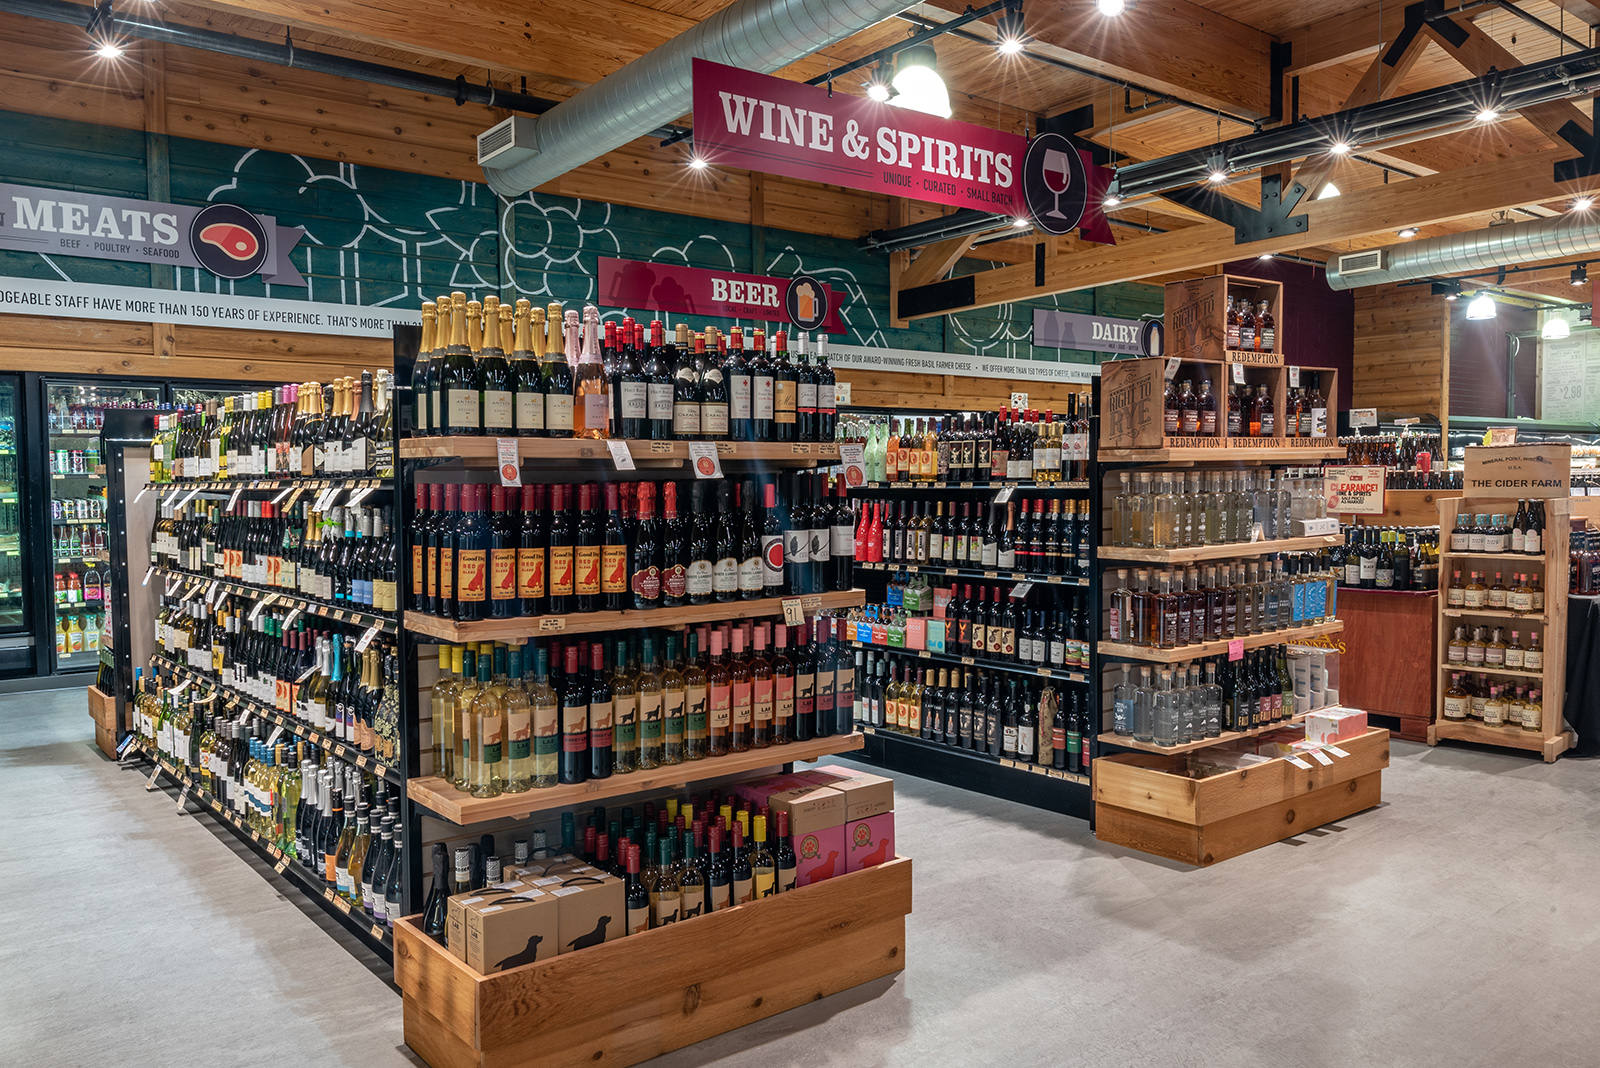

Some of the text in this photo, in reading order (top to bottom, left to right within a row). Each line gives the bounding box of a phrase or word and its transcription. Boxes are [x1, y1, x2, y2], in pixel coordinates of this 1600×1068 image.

[718, 91, 1013, 188] WINE & SPIRITS
[883, 171, 1013, 207] UNIQUE CURATED SMALL BATCH
[12, 196, 179, 246] MEATS
[60, 238, 180, 259] BEEF POULTRY SEAFOOD
[711, 278, 780, 308] BEER
[55, 294, 90, 309] STAFF
[93, 297, 122, 311] HAVE
[125, 300, 156, 314] MORE
[158, 302, 187, 317] THAN
[191, 305, 209, 318] 150
[211, 306, 245, 320] YEARS
[247, 309, 260, 321] OF
[263, 310, 324, 326] EXPERIENCE.
[327, 315, 358, 328] THAT'S
[360, 318, 385, 330] MORE
[722, 305, 780, 317] LOCAL CRAFT LIMITED
[1172, 299, 1214, 331] RIGHT TO
[1092, 321, 1140, 344] DAIRY
[1232, 351, 1280, 364] REDEMPTION
[844, 353, 851, 363] OF
[851, 354, 863, 364] OUR
[863, 355, 905, 367] AWARD-WINNING
[905, 358, 921, 367] FRESH
[921, 359, 935, 369] BASIL
[936, 360, 954, 370] FARMER
[955, 361, 972, 371] CHEESE
[981, 364, 990, 372] WE
[990, 365, 1002, 373] OFFER
[1002, 366, 1016, 374] MORE
[1016, 367, 1027, 375] THAN
[1027, 367, 1036, 376] 150
[1035, 368, 1048, 377] TYPES
[1048, 369, 1055, 377] OF
[1070, 370, 1081, 379] WITH
[1109, 381, 1151, 412] RIGHT TO
[1560, 385, 1582, 400] $2.98
[1109, 398, 1152, 437] RYE
[1170, 437, 1221, 448] REDEMPTION
[1233, 438, 1280, 448] REDEMPTION
[1290, 438, 1334, 447] REDEMPTION
[1482, 457, 1504, 466] MINERAL
[1330, 483, 1379, 492] CLEARANCE!
[1471, 479, 1562, 488] THE CIDER FARM
[786, 607, 797, 621] 91
[789, 787, 816, 796] LAB
[452, 920, 460, 930] LAB
